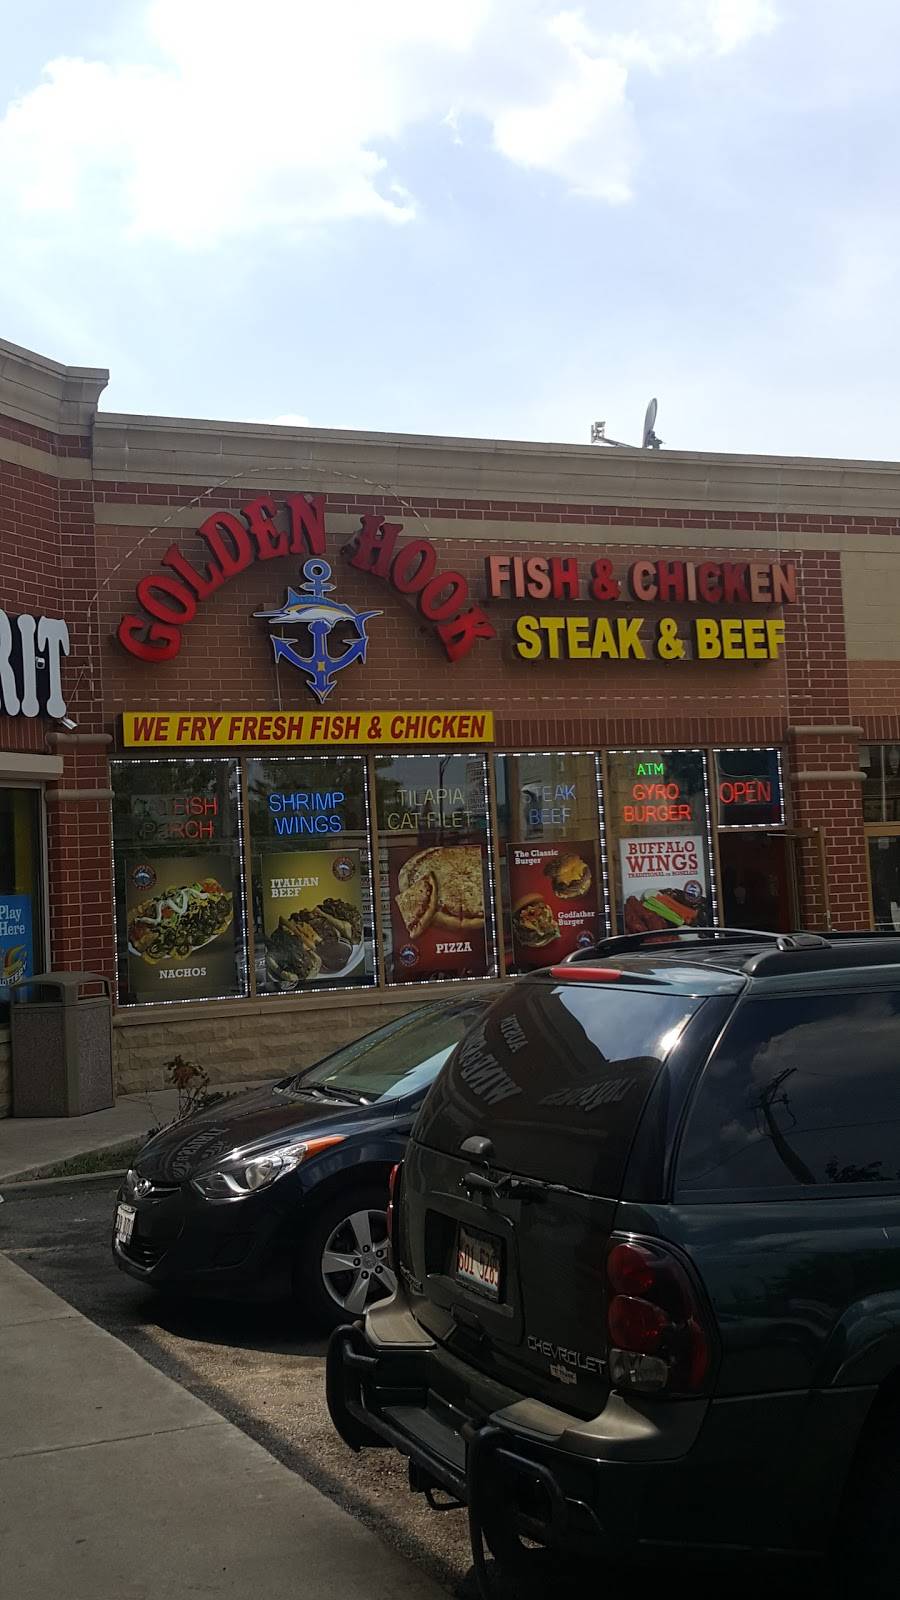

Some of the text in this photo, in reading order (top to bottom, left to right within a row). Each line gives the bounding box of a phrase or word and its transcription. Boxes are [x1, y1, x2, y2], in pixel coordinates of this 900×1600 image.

[117, 494, 497, 663] GOLDEN HOOK
[486, 554, 798, 604] FISH & CHICKEN
[514, 615, 786, 661] STEAK & BEEF
[133, 714, 486, 742] WE FRY FRESH FISH & CHICKEN
[636, 762, 664, 776] ATM
[396, 788, 465, 807] TILAPIA
[632, 783, 680, 801] GYRO
[719, 781, 772, 805] OPEN
[268, 791, 345, 812] SHRIMP
[387, 811, 473, 830] CAT FILET
[528, 807, 572, 825] BEEF
[623, 804, 691, 823] BURGER
[275, 815, 343, 835] WINGS
[530, 849, 559, 857] Classic
[627, 840, 696, 855] BUFFALO
[515, 857, 541, 866] Burger
[625, 853, 699, 872] WINGS
[271, 877, 319, 888] ITALIAN
[271, 887, 302, 898] BEEF
[0, 904, 22, 922] Play
[558, 911, 595, 919] Godfather
[558, 918, 584, 926] Burger
[0, 921, 26, 936] Here
[435, 941, 473, 954] PIZZA
[159, 966, 207, 980] NACHOS
[527, 1334, 608, 1377] CHEVROLET
